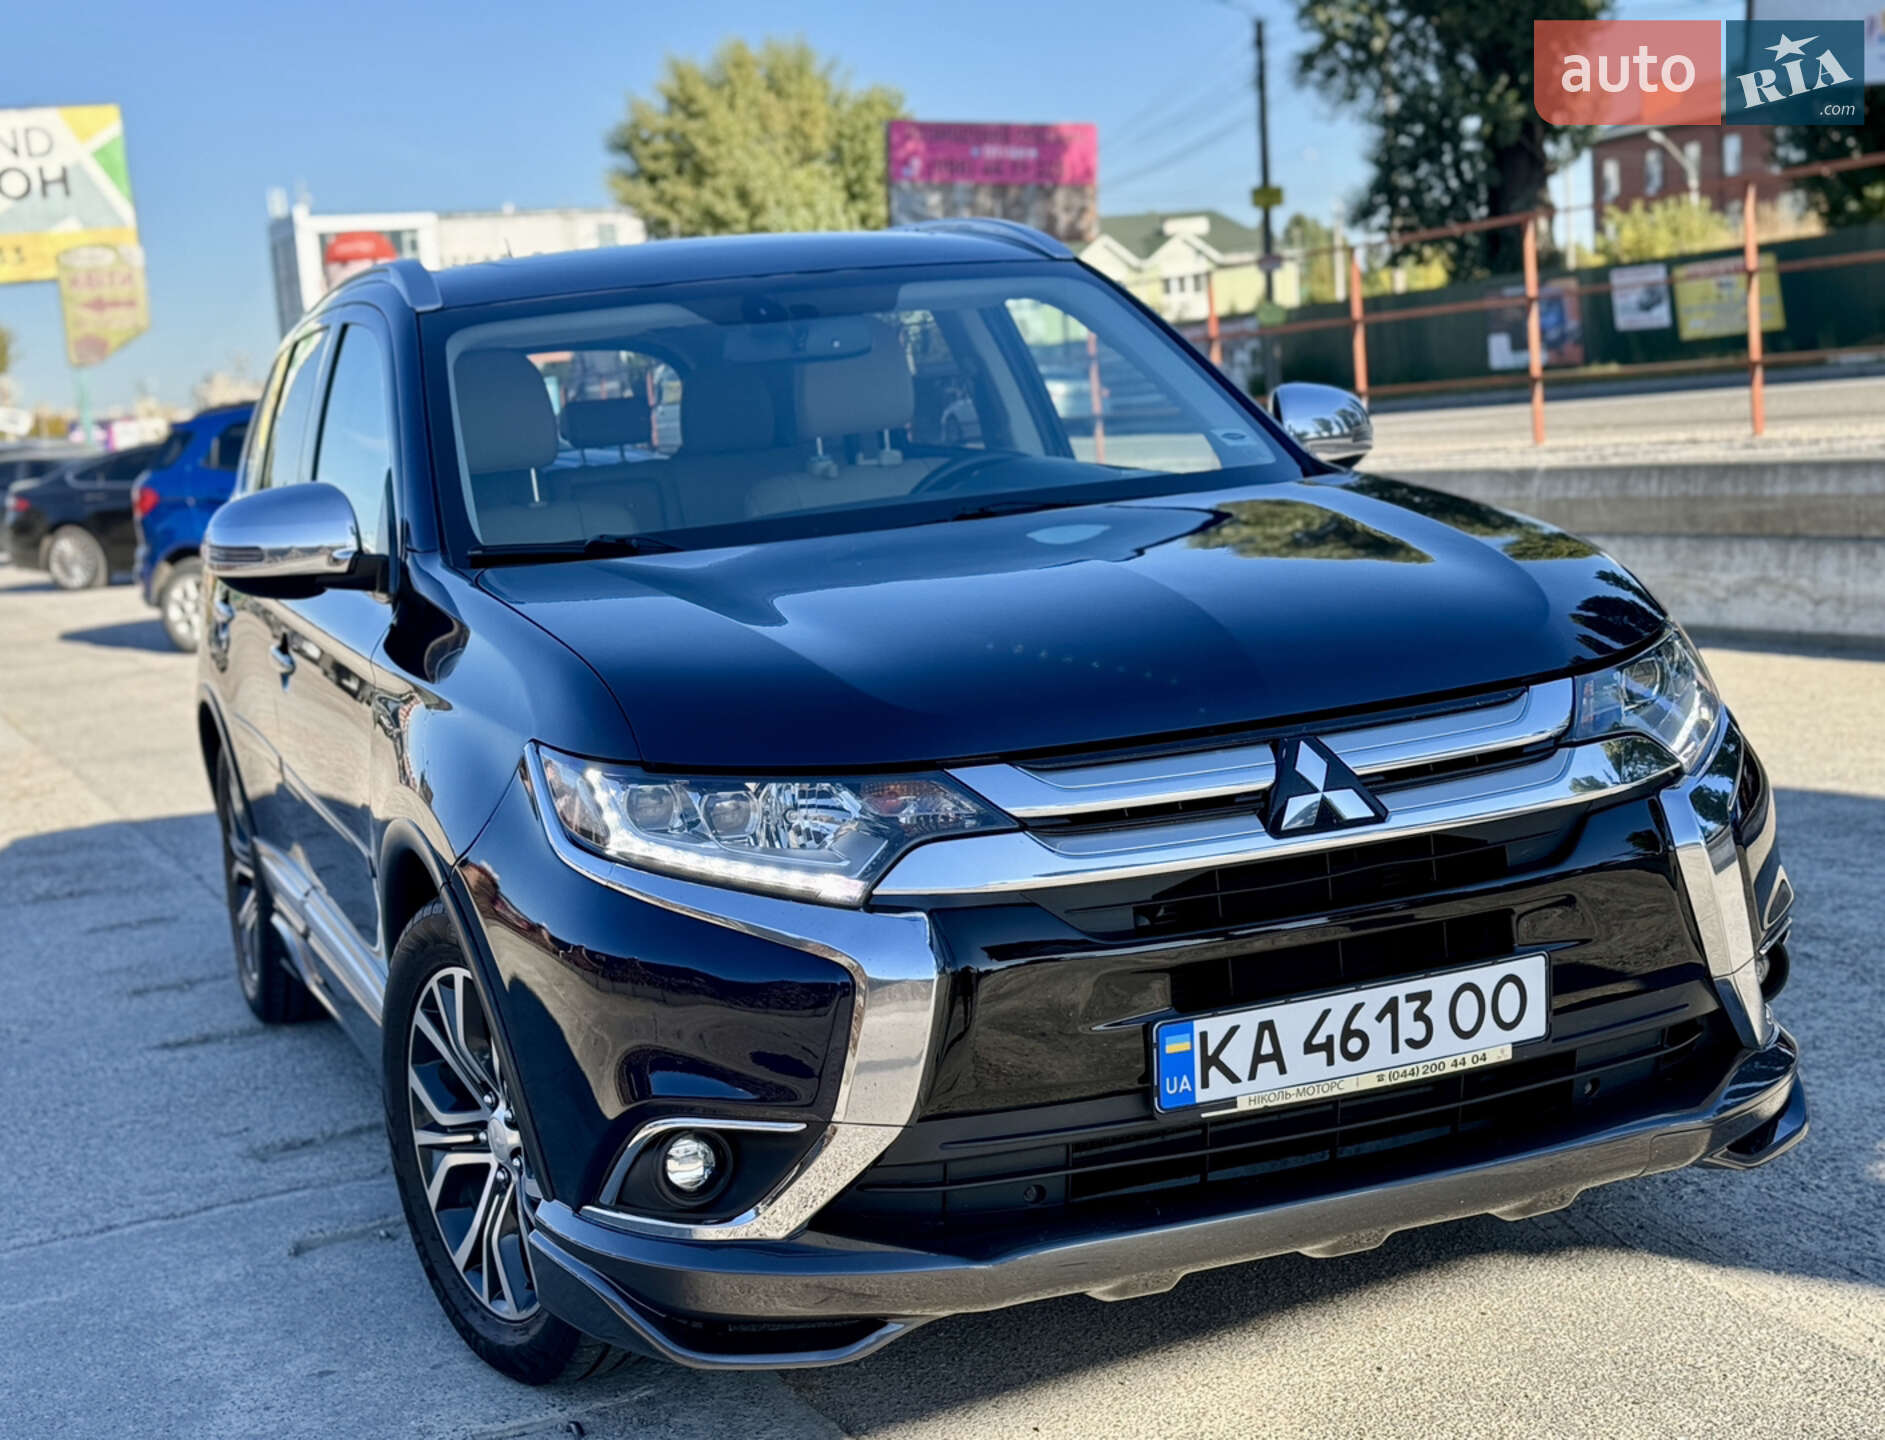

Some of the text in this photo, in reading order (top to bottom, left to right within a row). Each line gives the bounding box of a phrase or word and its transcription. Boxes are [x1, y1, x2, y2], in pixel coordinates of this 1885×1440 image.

[1199, 973, 1528, 1090] KA 4613 OO
[1388, 1052, 1487, 1083] (044) 200 44 04
[1165, 1074, 1193, 1095] UA
[1247, 1079, 1346, 1107] НІКОЛЬ-МОТОРС
